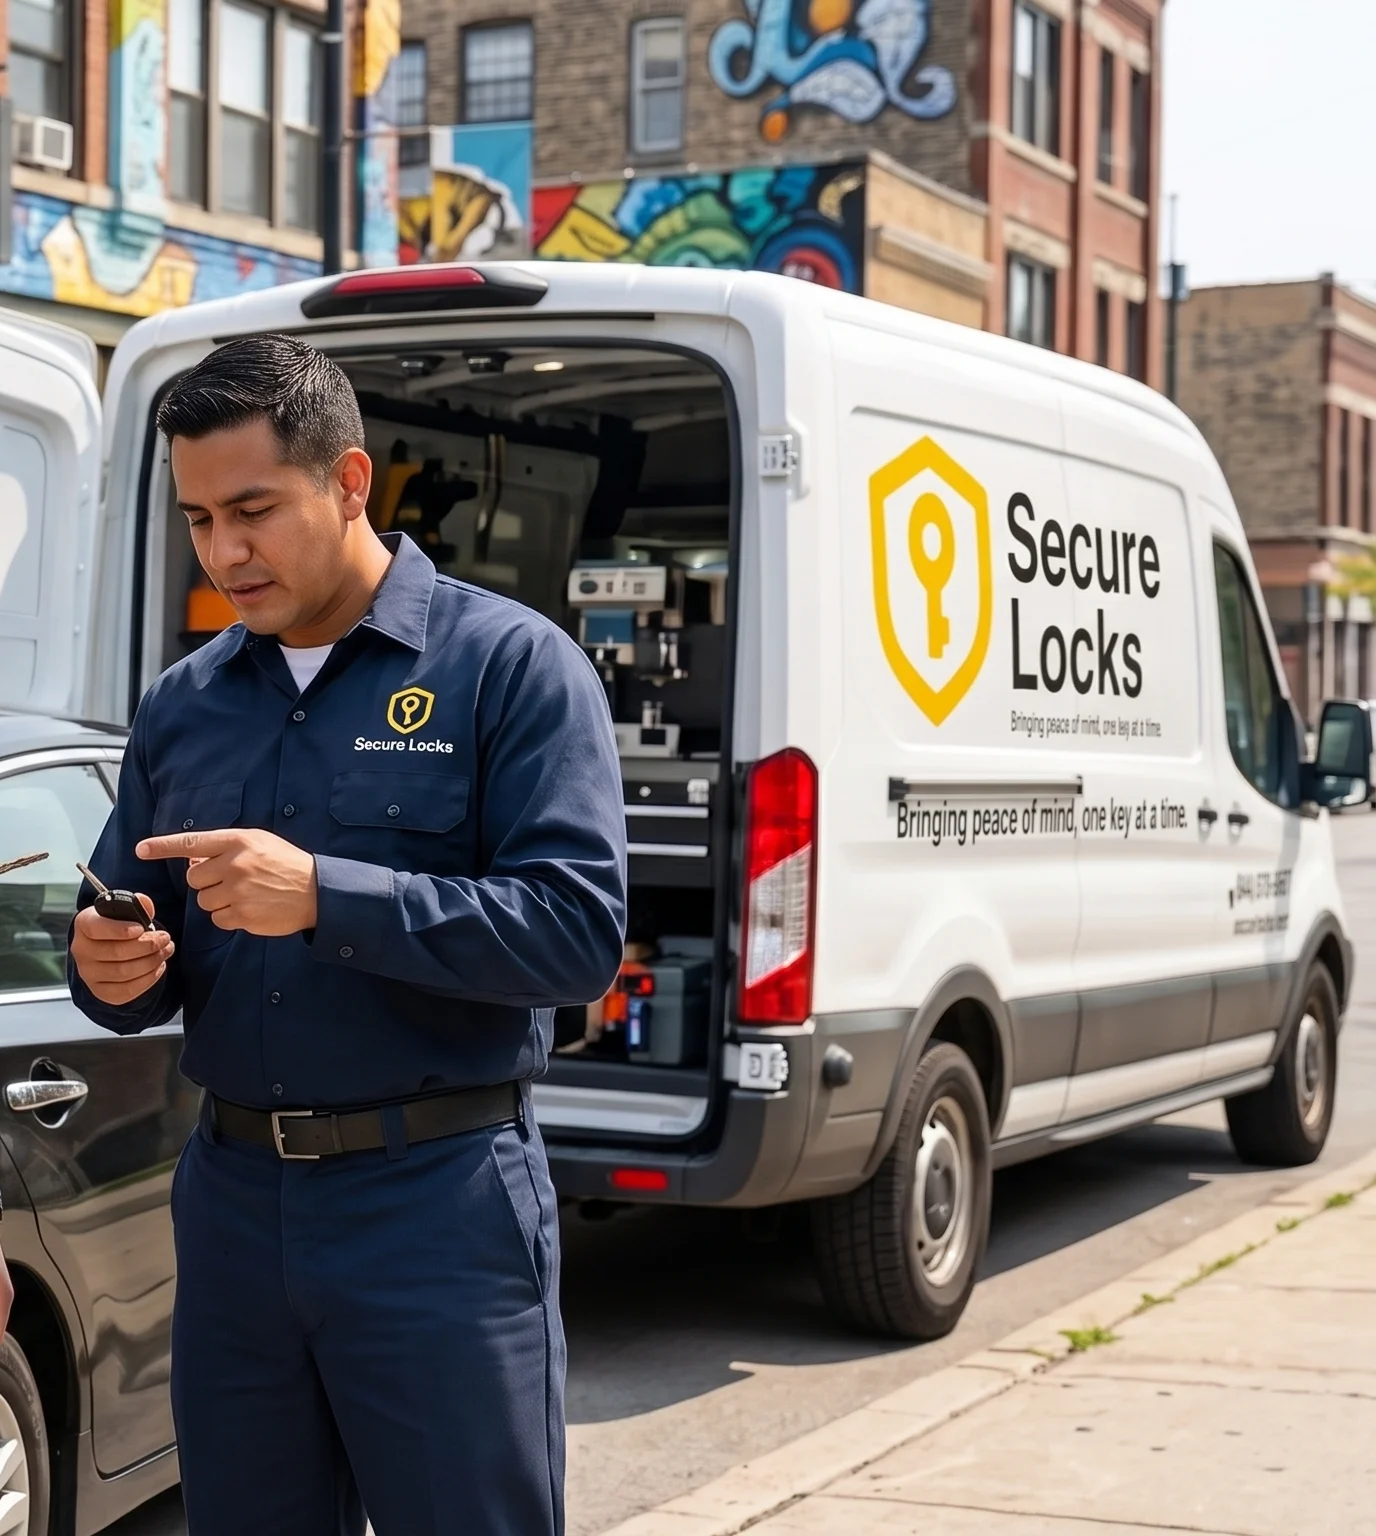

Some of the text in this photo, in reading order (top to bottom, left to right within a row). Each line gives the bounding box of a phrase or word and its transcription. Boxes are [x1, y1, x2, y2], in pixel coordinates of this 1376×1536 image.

[1007, 492, 1161, 599] Secure
[1011, 598, 1143, 699] Locks
[354, 737, 454, 753] Secure Locks
[1011, 710, 1044, 738] Bringing
[1046, 718, 1070, 738] peace
[896, 797, 1188, 847] Bringing peace of mind, one key at a time.
